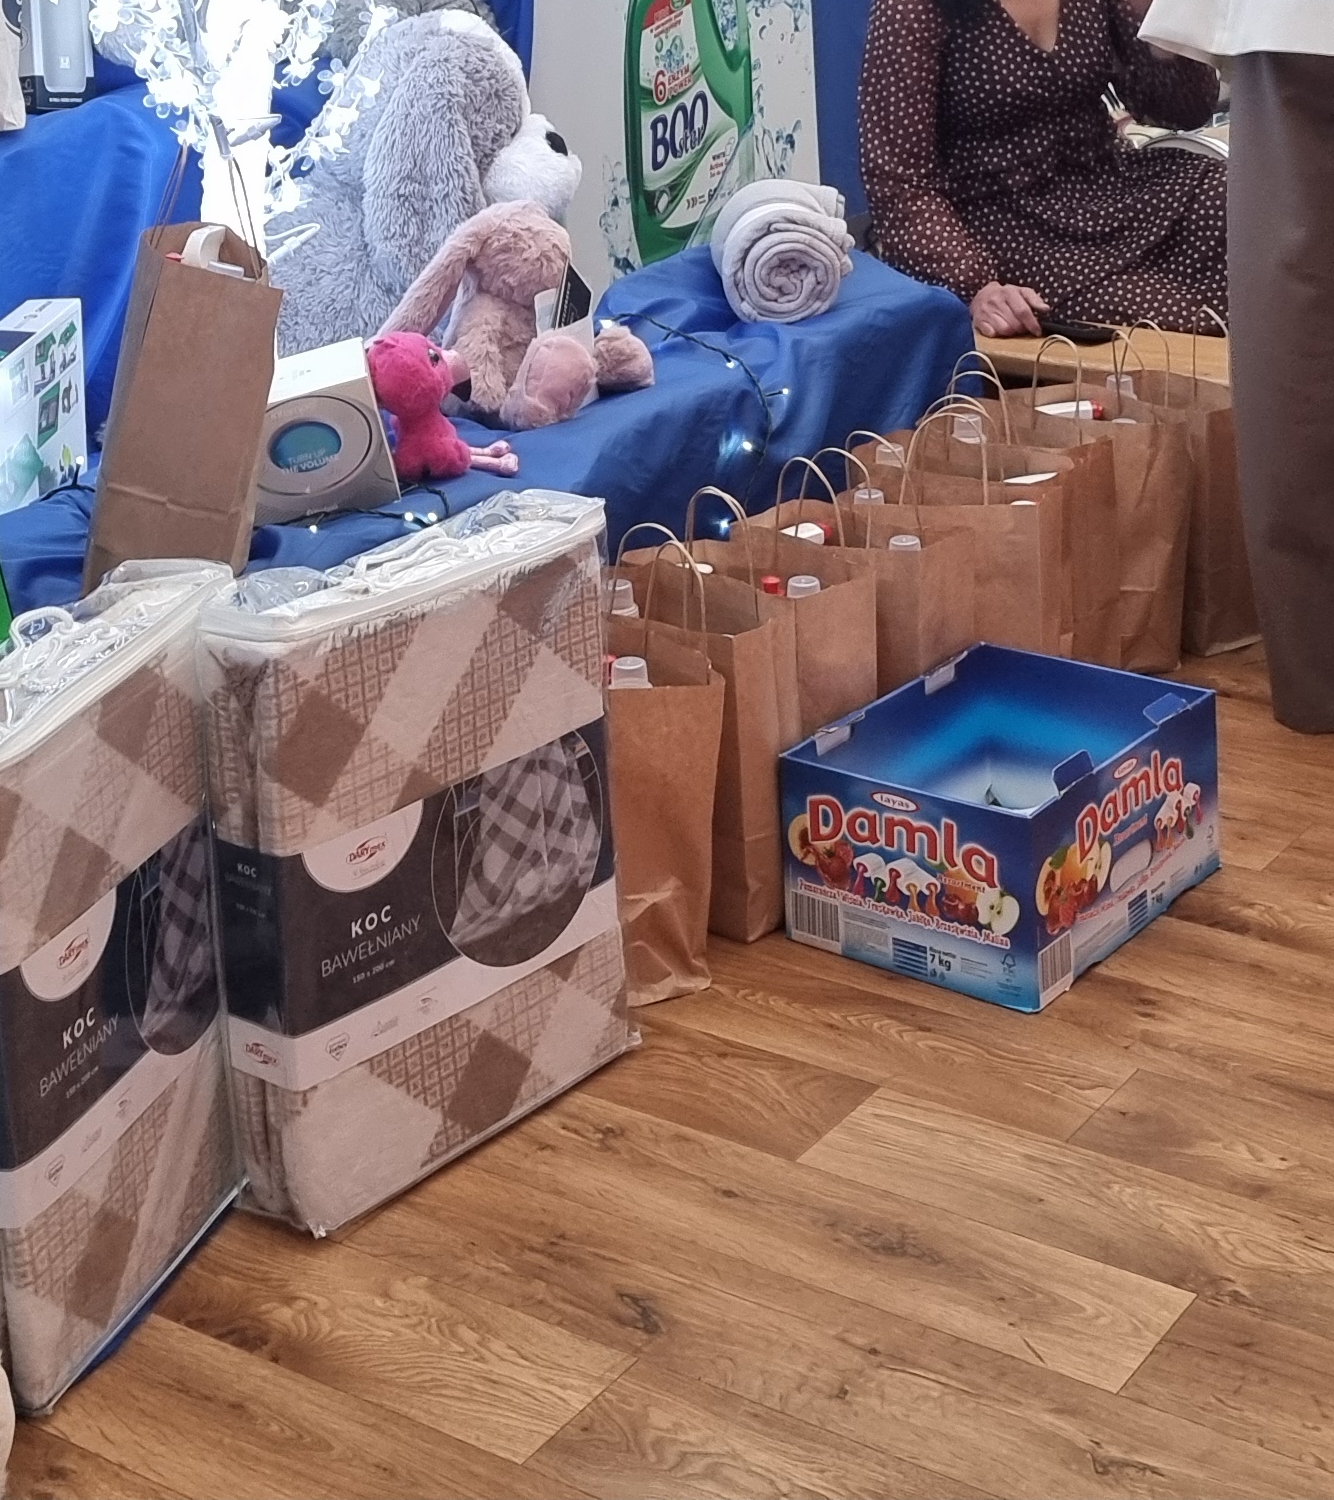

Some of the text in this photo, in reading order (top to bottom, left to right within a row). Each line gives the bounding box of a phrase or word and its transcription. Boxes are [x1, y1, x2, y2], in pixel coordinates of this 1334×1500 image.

[654, 69, 667, 102] 6
[288, 452, 311, 465] TURN
[880, 792, 911, 809] tayas
[1077, 750, 1182, 863] Damla
[807, 796, 999, 889] Damla
[237, 862, 256, 878] KOC
[351, 905, 392, 938] KOC
[321, 914, 421, 978] BAWEŁNIANY
[930, 953, 936, 963] 7
[938, 954, 951, 971] kg
[62, 1007, 95, 1050] KOC
[39, 1013, 119, 1098] BAWEŁNIANY
